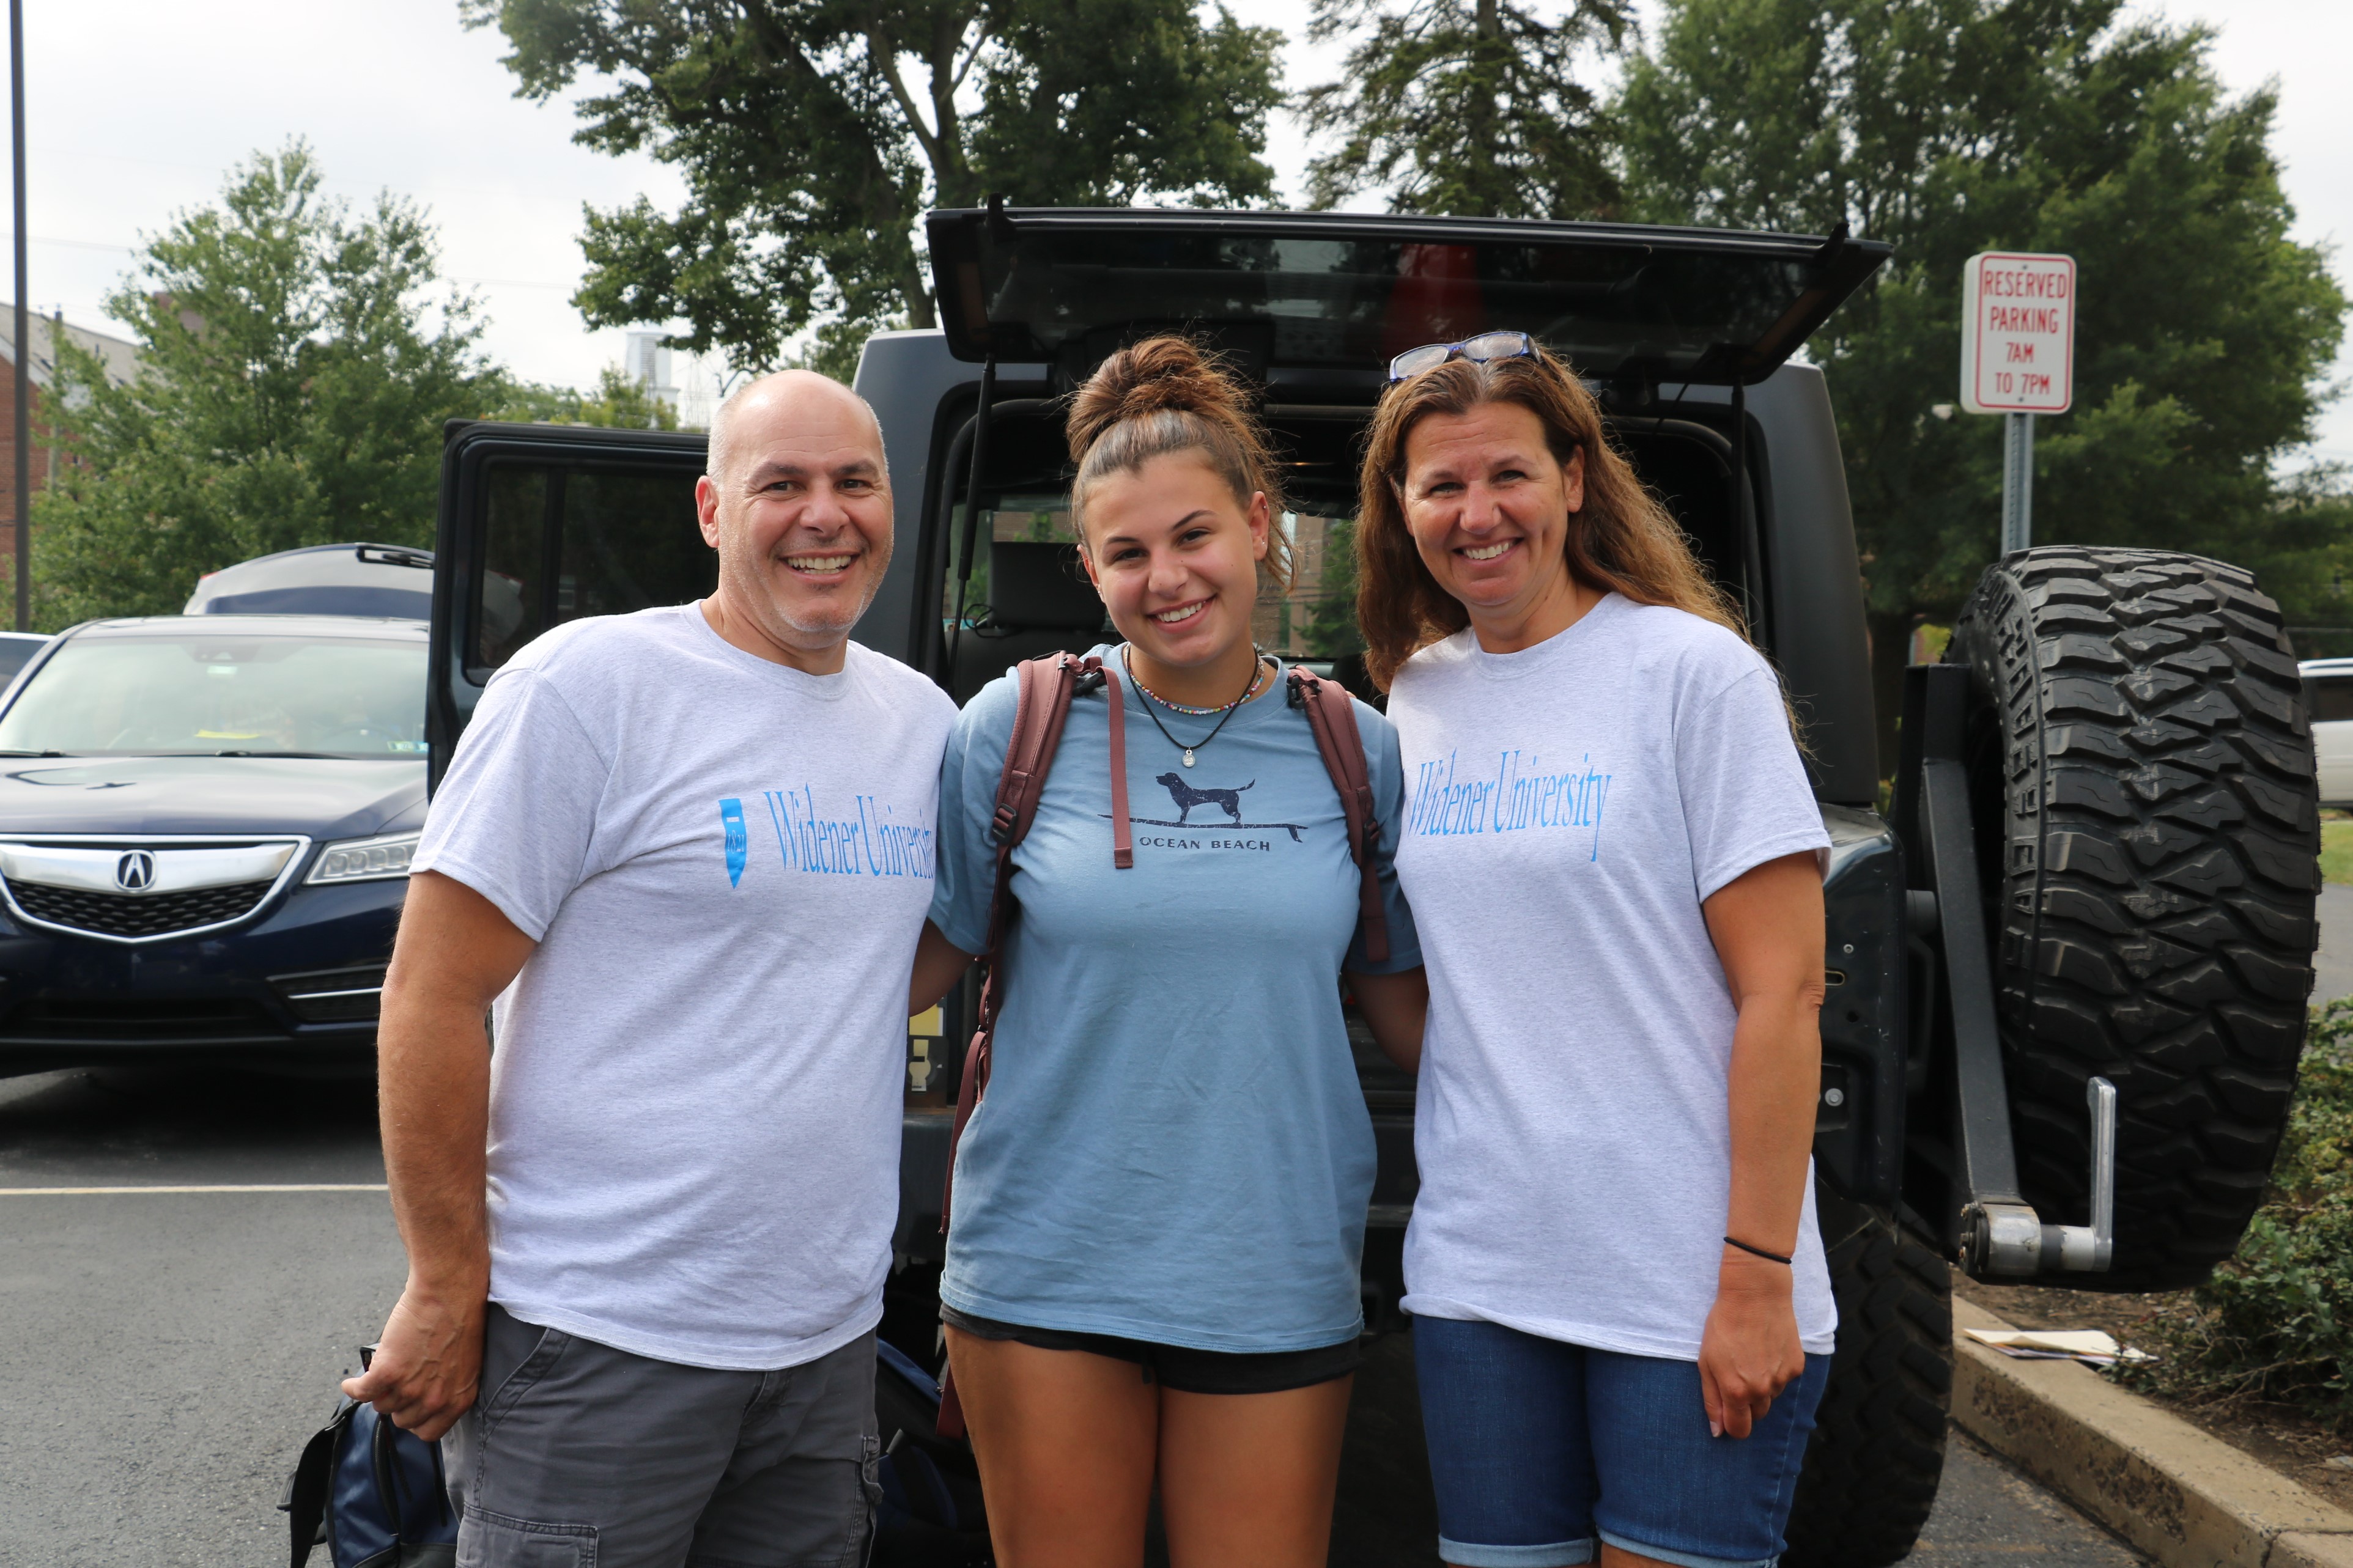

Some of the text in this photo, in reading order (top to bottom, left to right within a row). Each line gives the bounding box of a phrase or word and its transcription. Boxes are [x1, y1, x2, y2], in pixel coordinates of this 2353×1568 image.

[1984, 271, 2067, 298] RESERVED
[1990, 306, 2059, 334] PARKING
[2006, 342, 2034, 363] 7AM
[1995, 372, 2050, 395] TO 7PM
[1408, 746, 1612, 862] Widener University
[763, 782, 862, 874] Widener
[727, 830, 745, 854] 1821
[1139, 836, 1270, 852] OCEAN BEACH
